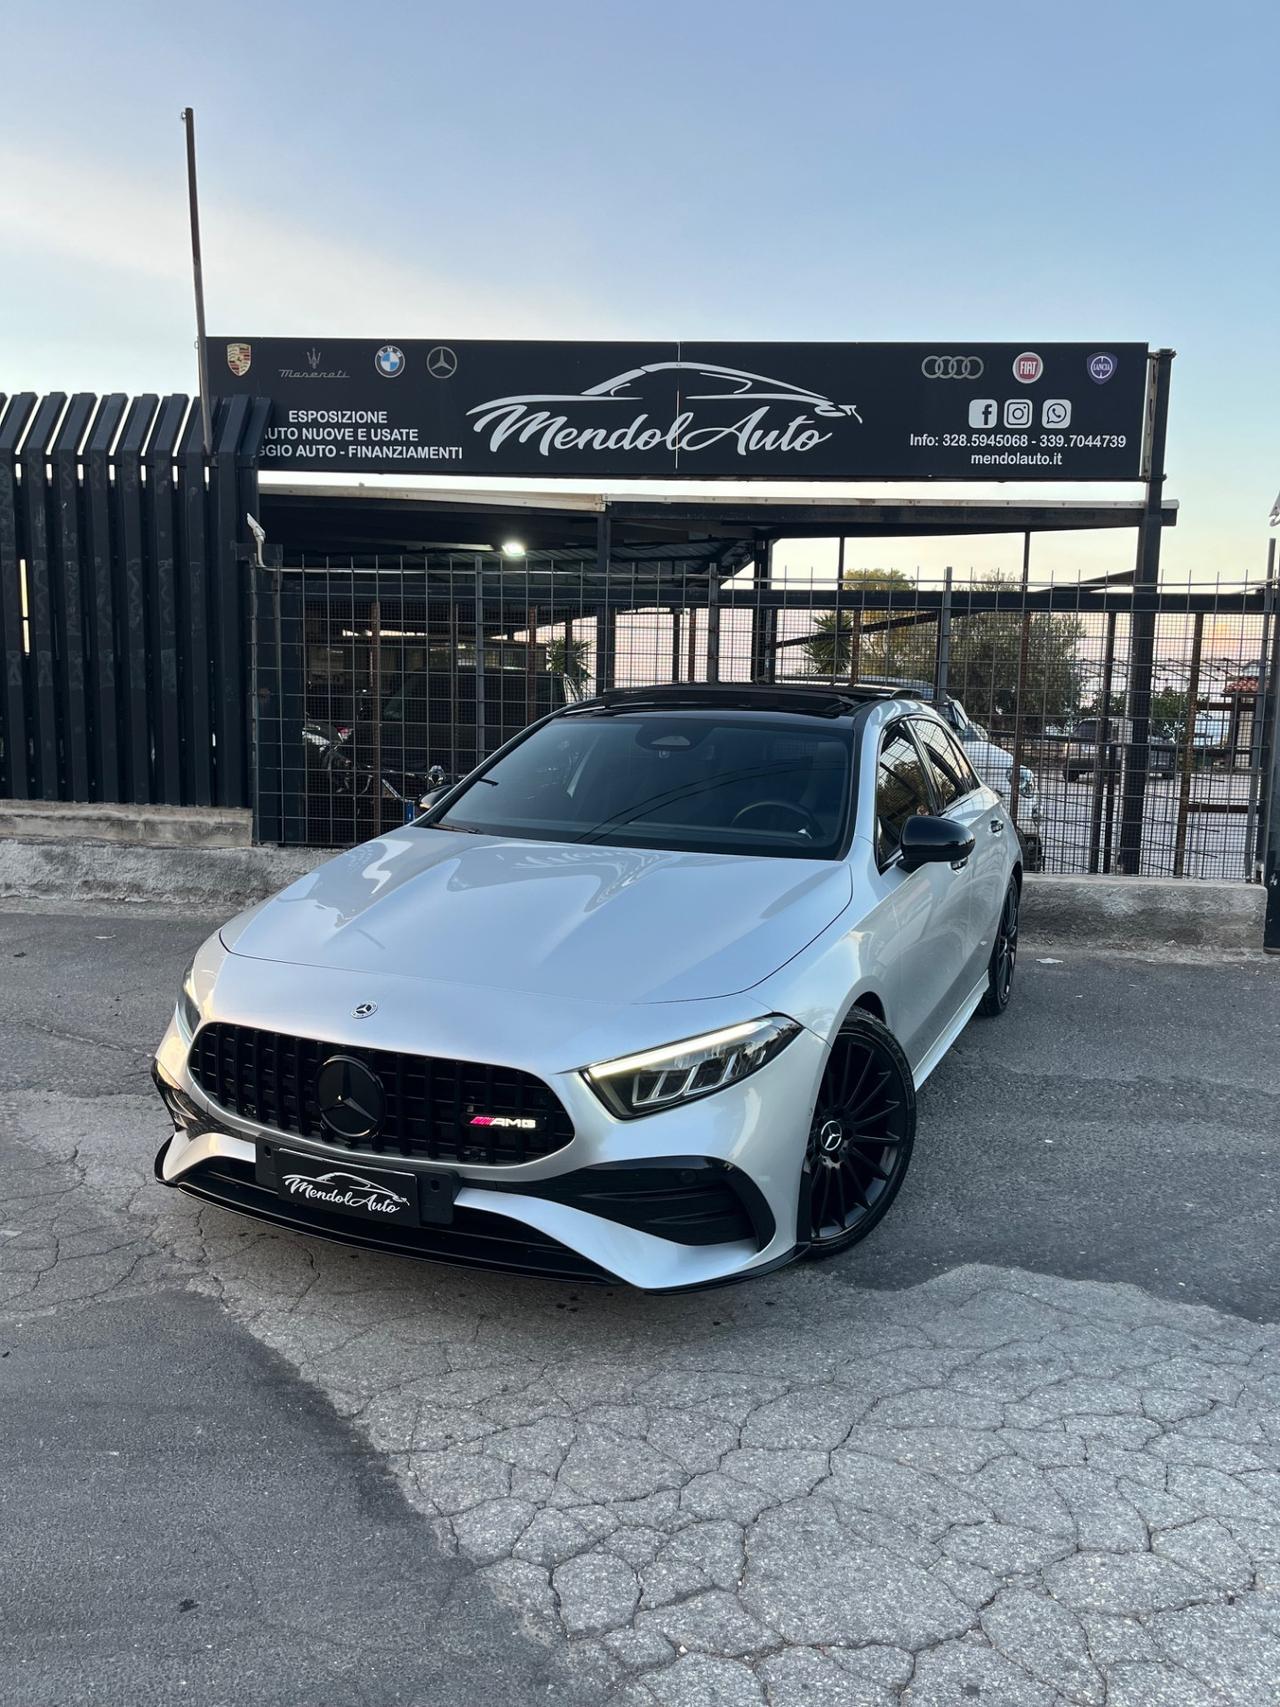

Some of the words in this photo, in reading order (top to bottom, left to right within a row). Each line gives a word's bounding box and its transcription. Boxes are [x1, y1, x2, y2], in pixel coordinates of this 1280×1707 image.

[278, 368, 351, 378] Maserati
[1019, 360, 1037, 375] FIAT
[288, 410, 388, 424] ESPOSIZIONE
[264, 427, 299, 441] UTO
[302, 427, 354, 441] NUOVE
[357, 428, 368, 441] E
[371, 428, 419, 442] USATE
[909, 433, 939, 447] Info:
[942, 434, 1028, 447] 328.5945068
[1039, 434, 1127, 448] 339.7044739
[295, 444, 337, 458] AUTO
[348, 445, 463, 460] FINANZIAMENTI
[970, 452, 1063, 466] mendolauto.it
[489, 1117, 537, 1129] AMG
